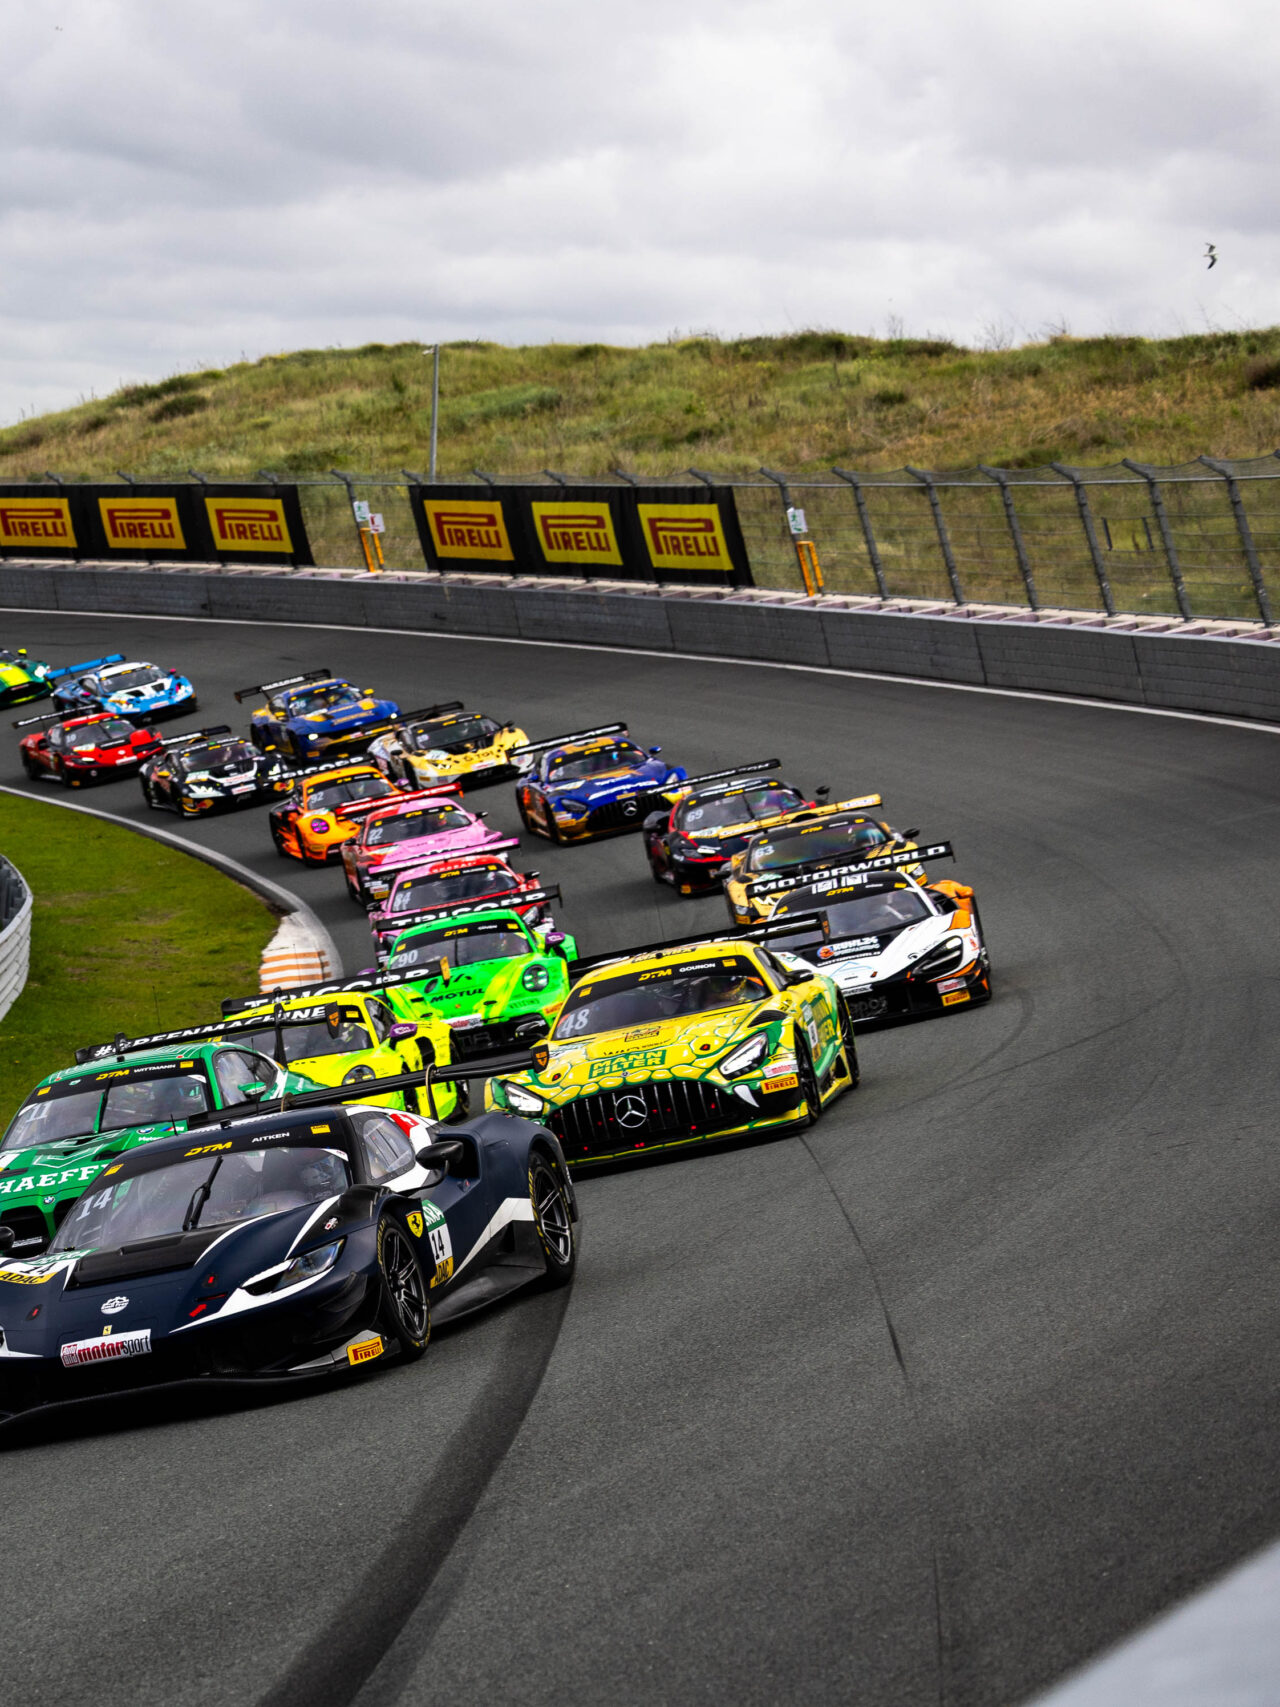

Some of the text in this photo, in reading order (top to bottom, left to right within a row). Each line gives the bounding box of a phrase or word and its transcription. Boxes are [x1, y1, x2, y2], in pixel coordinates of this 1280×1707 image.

[107, 508, 176, 540] PIRELLI
[215, 508, 284, 542] PIRELLI
[433, 512, 504, 549] PIRELLI
[540, 514, 612, 553] PIRELLI
[648, 517, 721, 558] PIRELLI
[267, 755, 365, 781] TRICORP
[310, 791, 324, 803] 92
[686, 810, 704, 823] 69
[369, 828, 383, 841] 22
[753, 845, 947, 894] MOTORWORLD
[397, 949, 419, 968] 90
[638, 969, 672, 982] DTM
[678, 963, 716, 974] GOUNON
[431, 987, 485, 1004] MOTUL
[94, 1006, 326, 1058] #REENMACHINE
[556, 1008, 591, 1038] 48
[134, 1063, 177, 1073] WITTMANN
[592, 1051, 663, 1070] MANN
[592, 1056, 664, 1077] FILTER
[96, 1069, 130, 1081] DTM
[764, 1076, 796, 1091] PIRELLI
[27, 1103, 53, 1122] 11
[251, 1131, 290, 1143] AITKEN
[183, 1141, 233, 1157] DTM
[76, 1186, 113, 1222] 14
[431, 1229, 445, 1260] 14
[20, 1262, 57, 1275] 14
[77, 1335, 151, 1363] motorsport
[352, 1341, 383, 1361] PIRELLI
